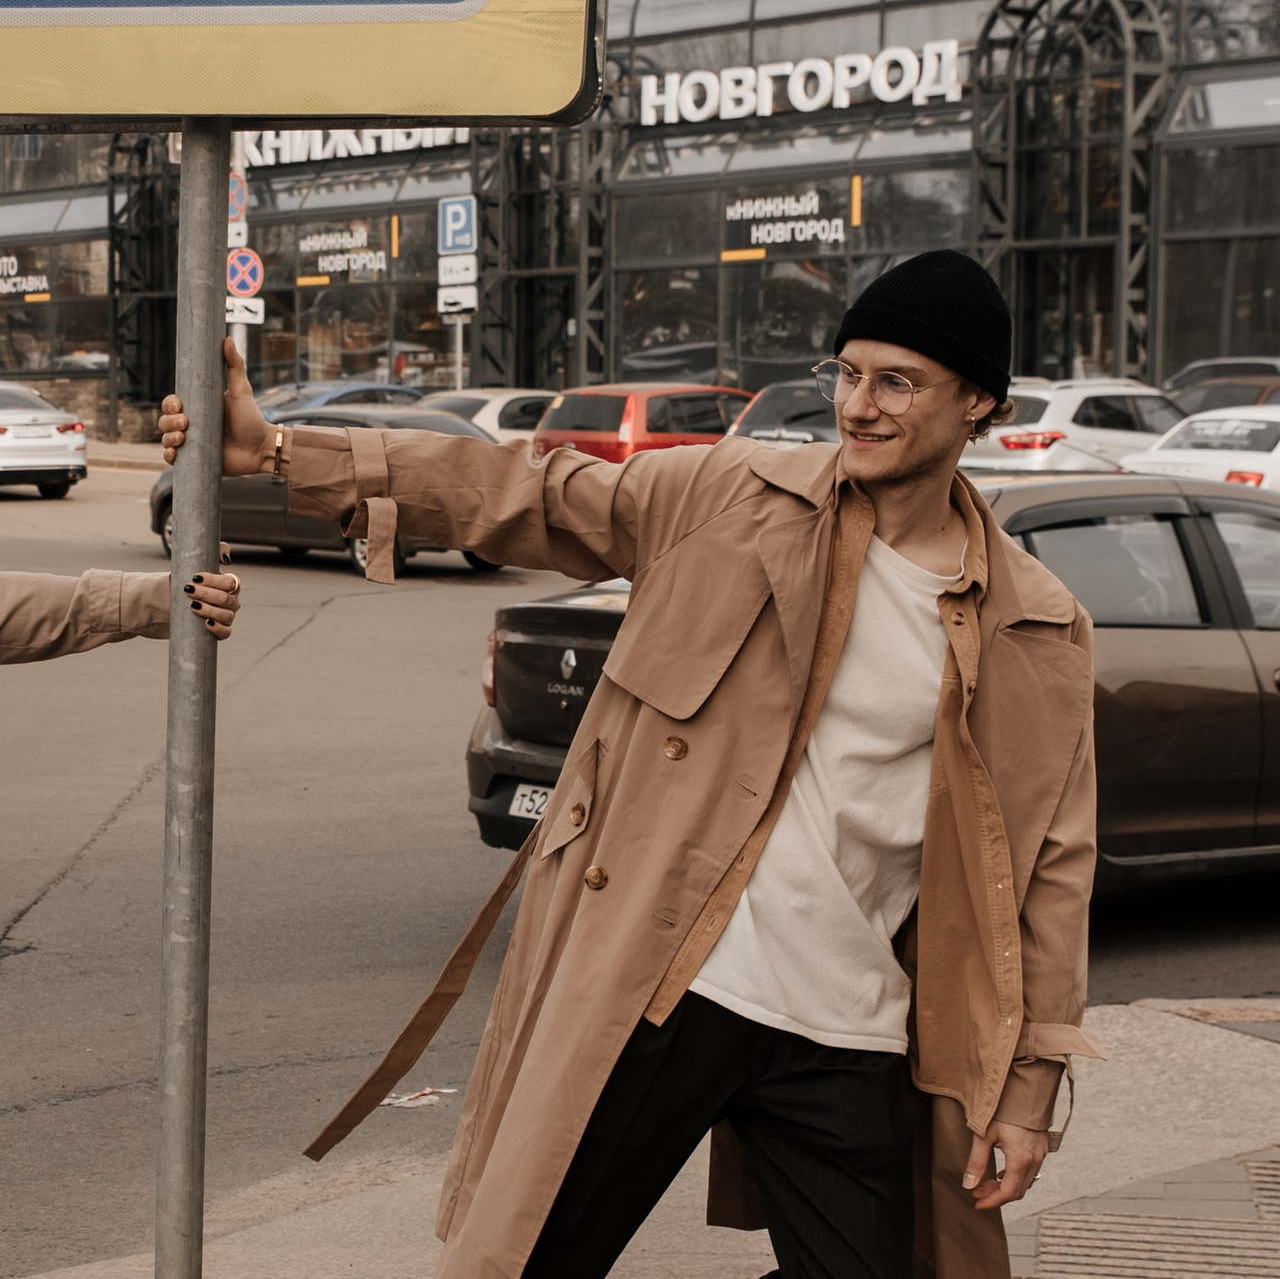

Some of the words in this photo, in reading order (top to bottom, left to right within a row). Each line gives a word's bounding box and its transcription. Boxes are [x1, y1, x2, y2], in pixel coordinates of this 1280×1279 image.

[641, 39, 962, 126] НОВГОРОД
[446, 203, 467, 248] P
[750, 218, 845, 245] НОВГОРОД
[318, 250, 387, 273] НОВГОРОД
[547, 682, 585, 696] LOGAN
